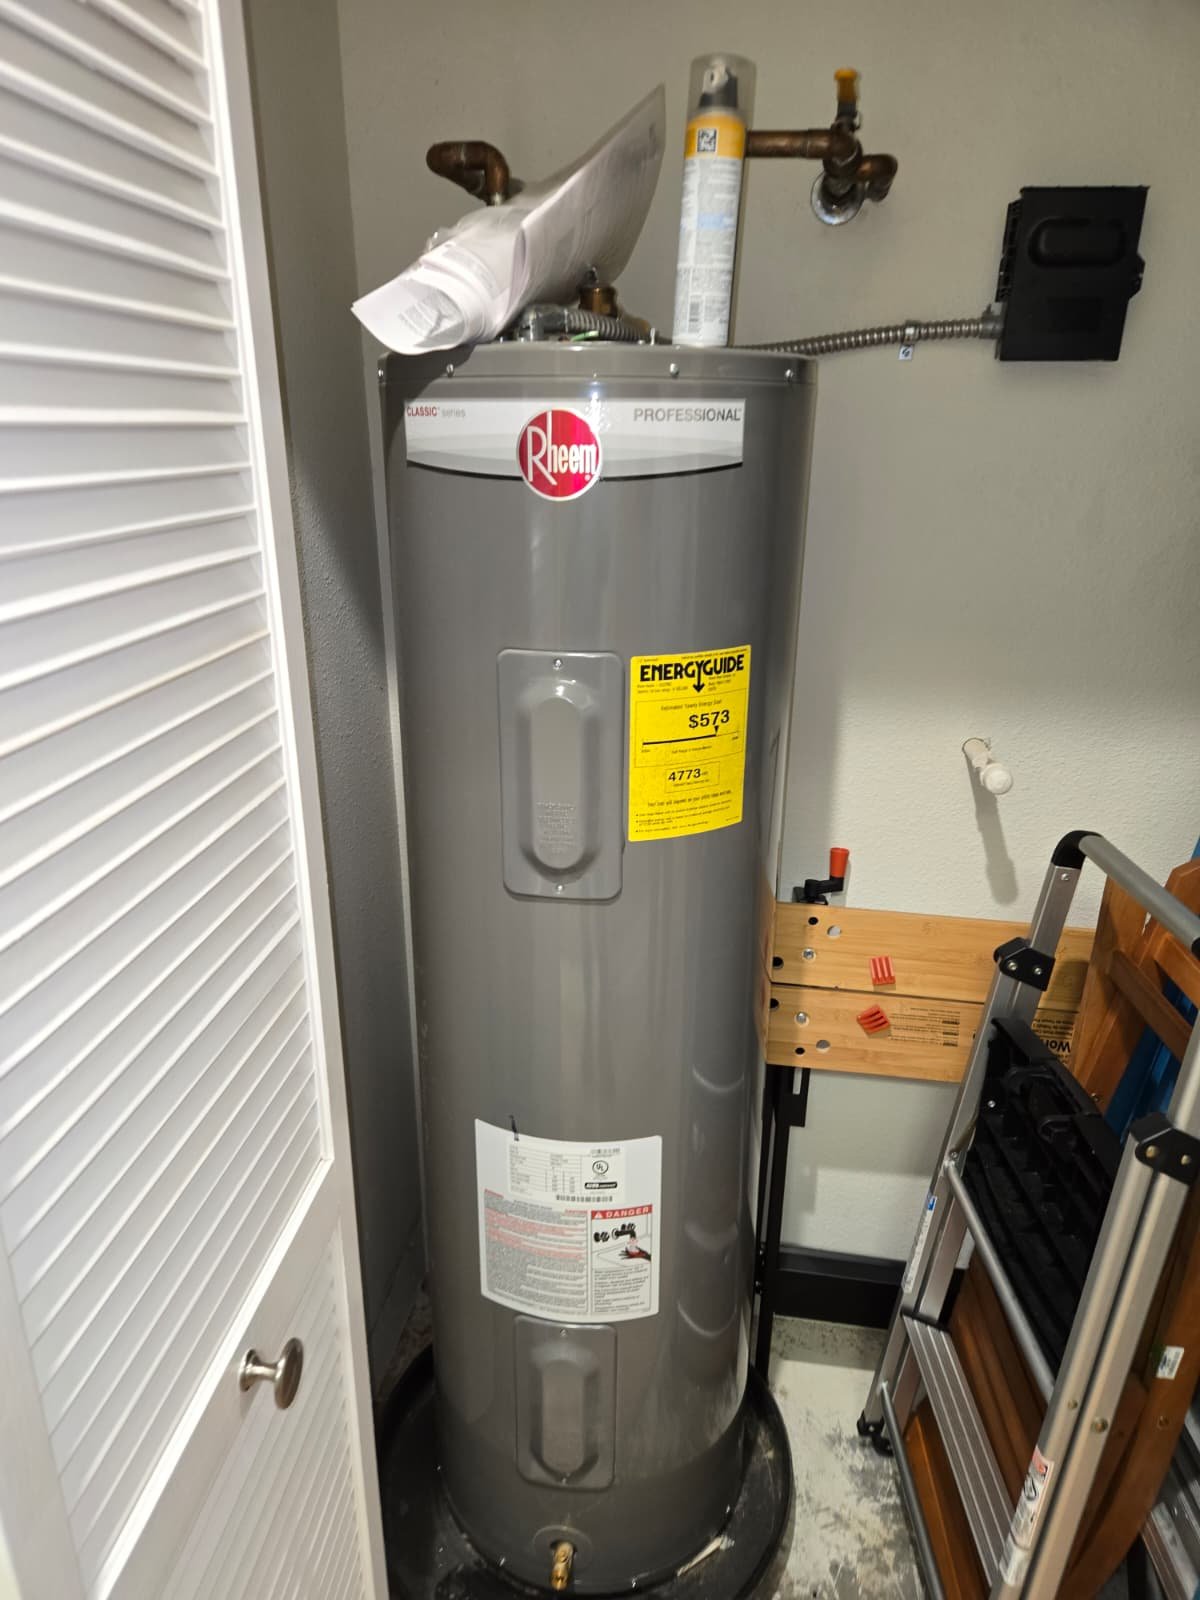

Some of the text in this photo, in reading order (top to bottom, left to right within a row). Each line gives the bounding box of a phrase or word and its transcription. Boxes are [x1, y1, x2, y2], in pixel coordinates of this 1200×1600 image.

[406, 406, 466, 417] CLASSIC series
[633, 408, 741, 421] PROFESSIONAL
[527, 411, 597, 486] Rheem
[640, 654, 744, 683] ENERGYGUIDE
[688, 709, 730, 729] $573
[668, 768, 701, 782] 4773
[605, 1206, 649, 1219] DANGER
